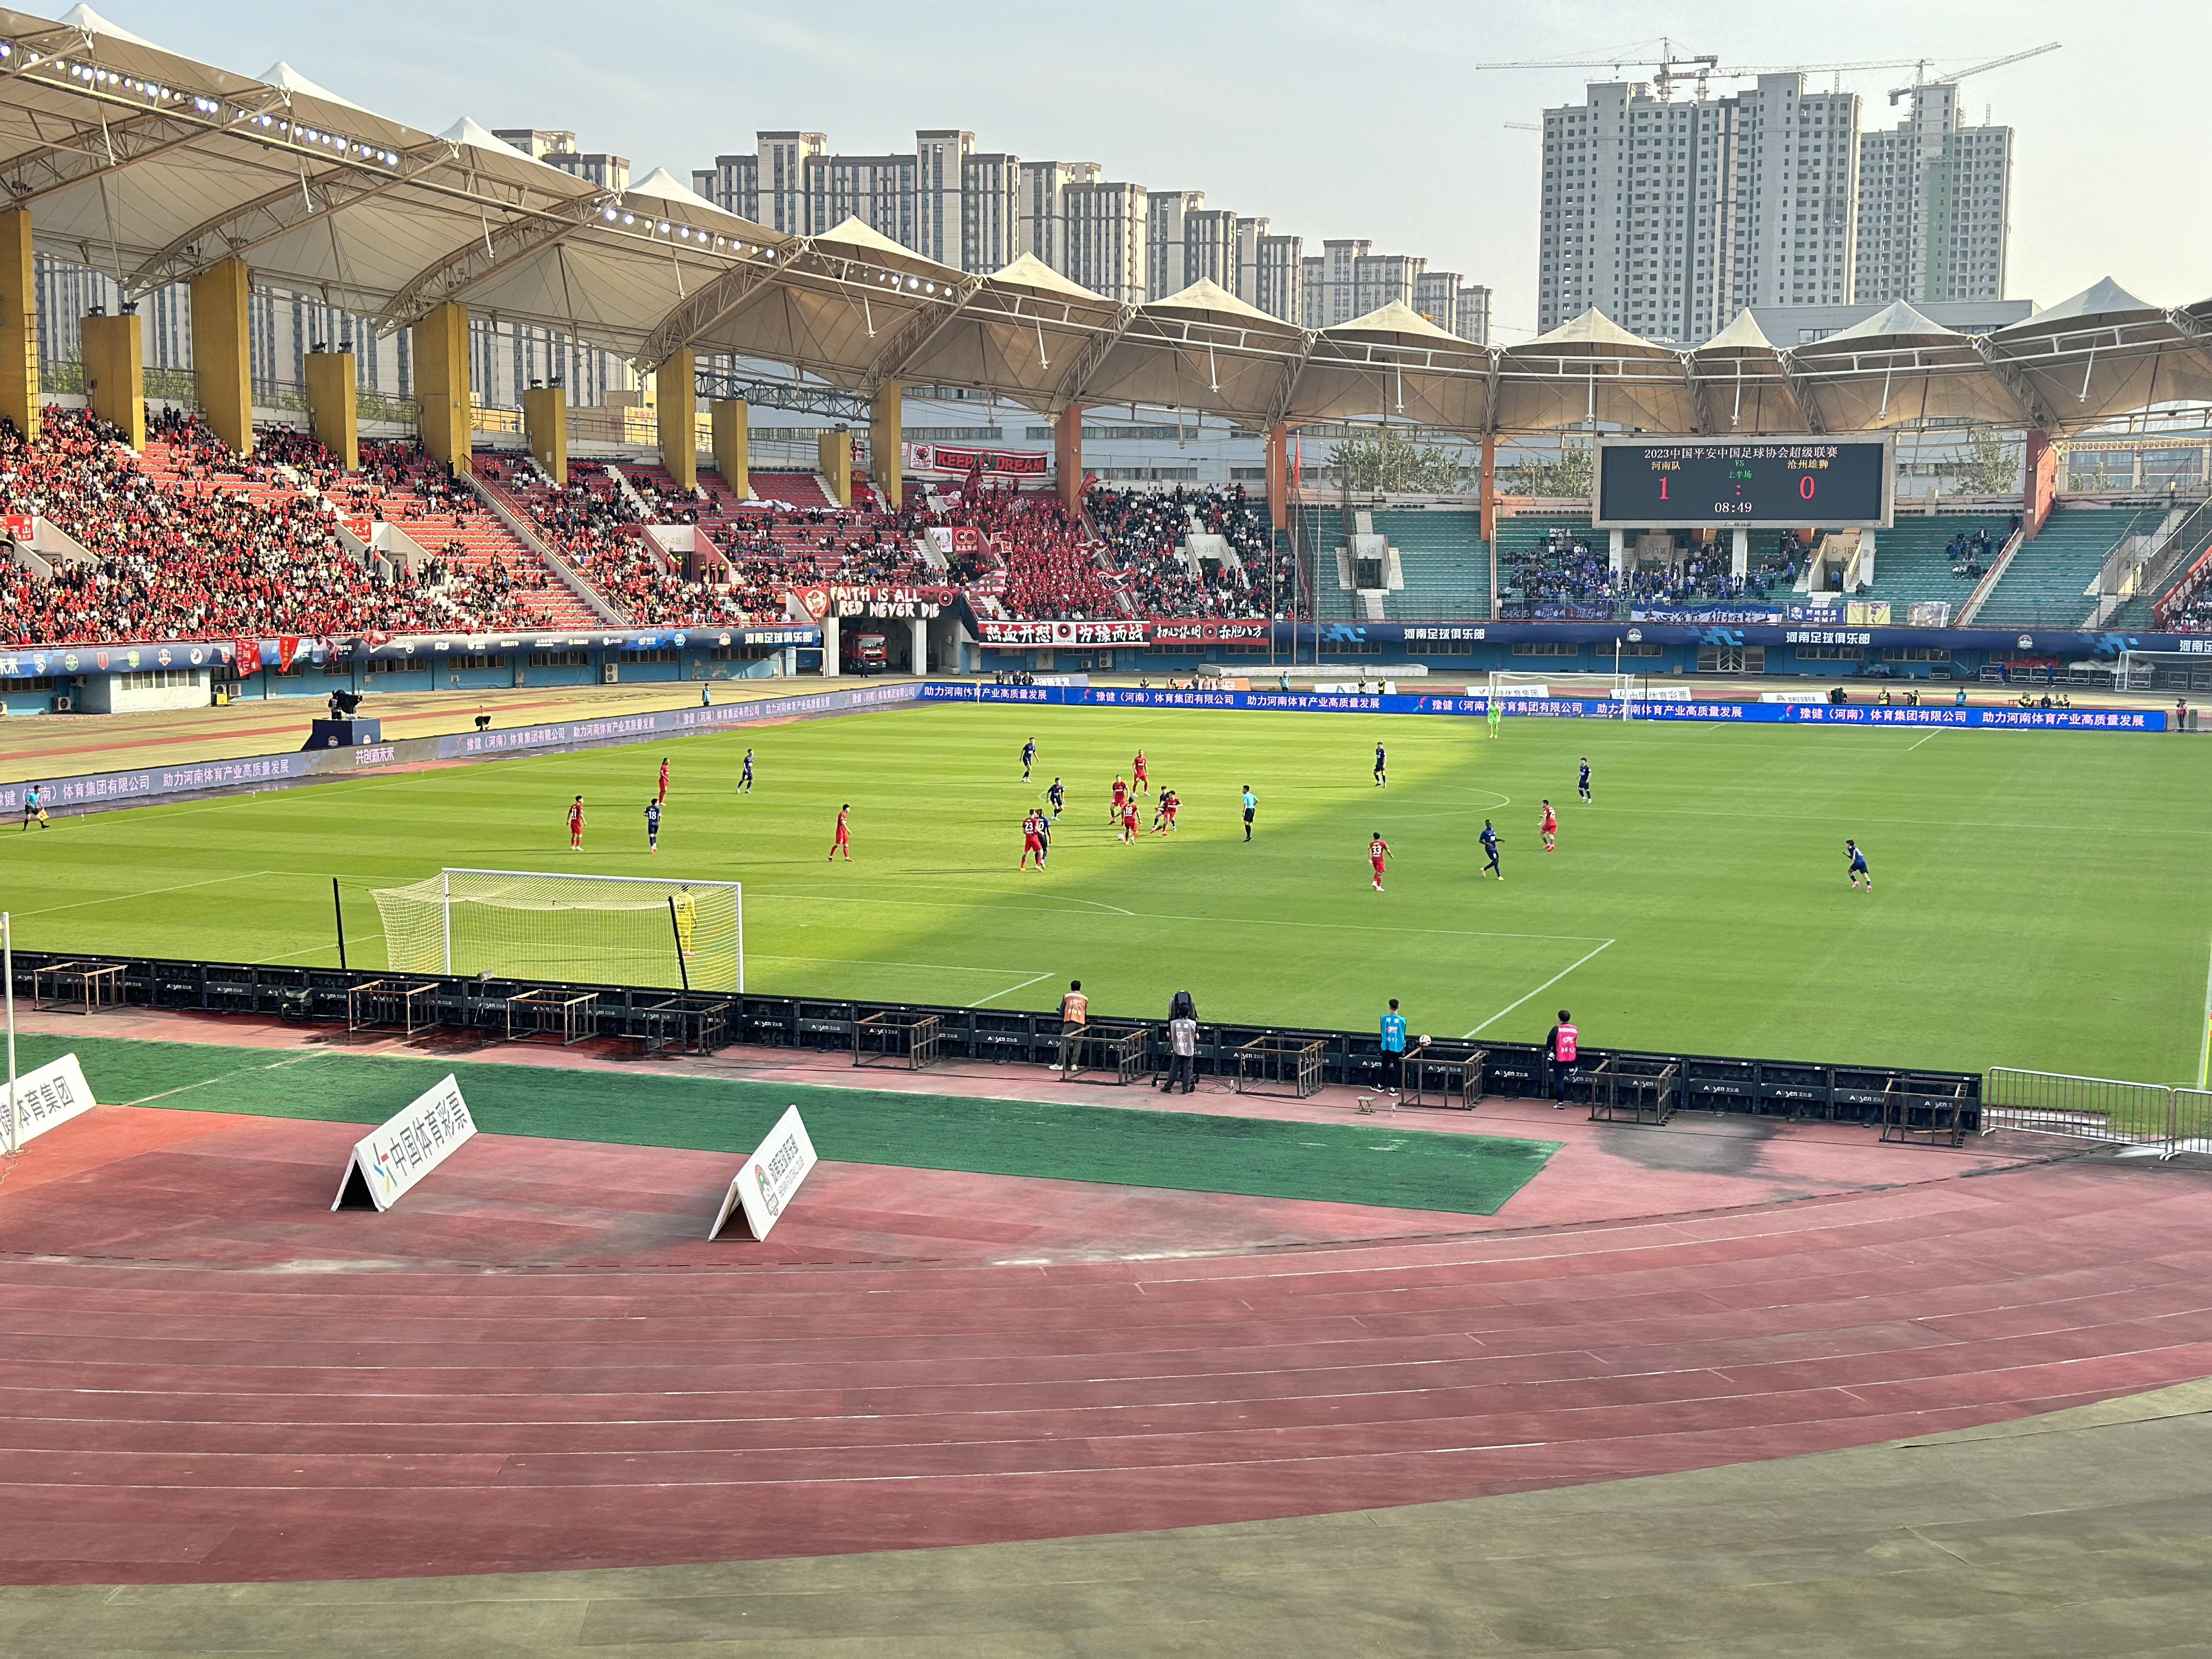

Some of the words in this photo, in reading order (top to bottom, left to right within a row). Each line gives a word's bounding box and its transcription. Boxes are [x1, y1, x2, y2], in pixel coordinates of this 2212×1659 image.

[1645, 447, 1838, 460] 2023中国平安中国足球协会超级联赛
[937, 451, 974, 469] KEEP
[996, 456, 1047, 472] DREAM
[1651, 461, 1681, 471] 河南队
[1787, 459, 1829, 470] 沧州雄狮
[1728, 470, 1752, 479] 上半场
[1658, 477, 1669, 500] 1
[1799, 476, 1815, 500] 0
[1714, 502, 1752, 514] 08:49
[830, 586, 871, 602] FAITH
[878, 588, 889, 602] IS
[894, 588, 922, 602] ALL
[839, 601, 864, 616] RED
[870, 602, 915, 617] NEVER
[922, 603, 940, 618] DIE
[744, 631, 812, 645] 河南足球俱乐部
[1404, 628, 1485, 640] 河南足球俱乐部
[1786, 631, 1870, 644] 河南足球俱乐部
[2179, 640, 2212, 653] 河南足
[924, 685, 1047, 700] 助力河南体育产业高质量发展
[1096, 690, 1234, 706] 豫健（河南）体育集团有限公司
[1247, 695, 1380, 709] 助力河南体育产业高质量发展
[1597, 701, 1742, 718] 助力河南体育产业高质量发展
[1800, 708, 1967, 723] 豫健（河南）体育集团有限公司
[1983, 711, 2144, 727] 助力河南体育产业高质量发展
[467, 727, 565, 751] 豫健（河南）体育集团有限公司
[573, 716, 655, 738] 助力河南体育产业高质量发展
[766, 697, 830, 716] 助力河南体育产业高质量发展
[0, 775, 150, 808] 健（南）体育集团有限公司
[163, 759, 289, 788] 助力河南体育产业高质量发展
[648, 810, 657, 820] 18
[1125, 806, 1133, 814] 18
[1025, 822, 1033, 832] 23
[1372, 845, 1381, 855] 33
[390, 1090, 467, 1177] 中国体育彩票
